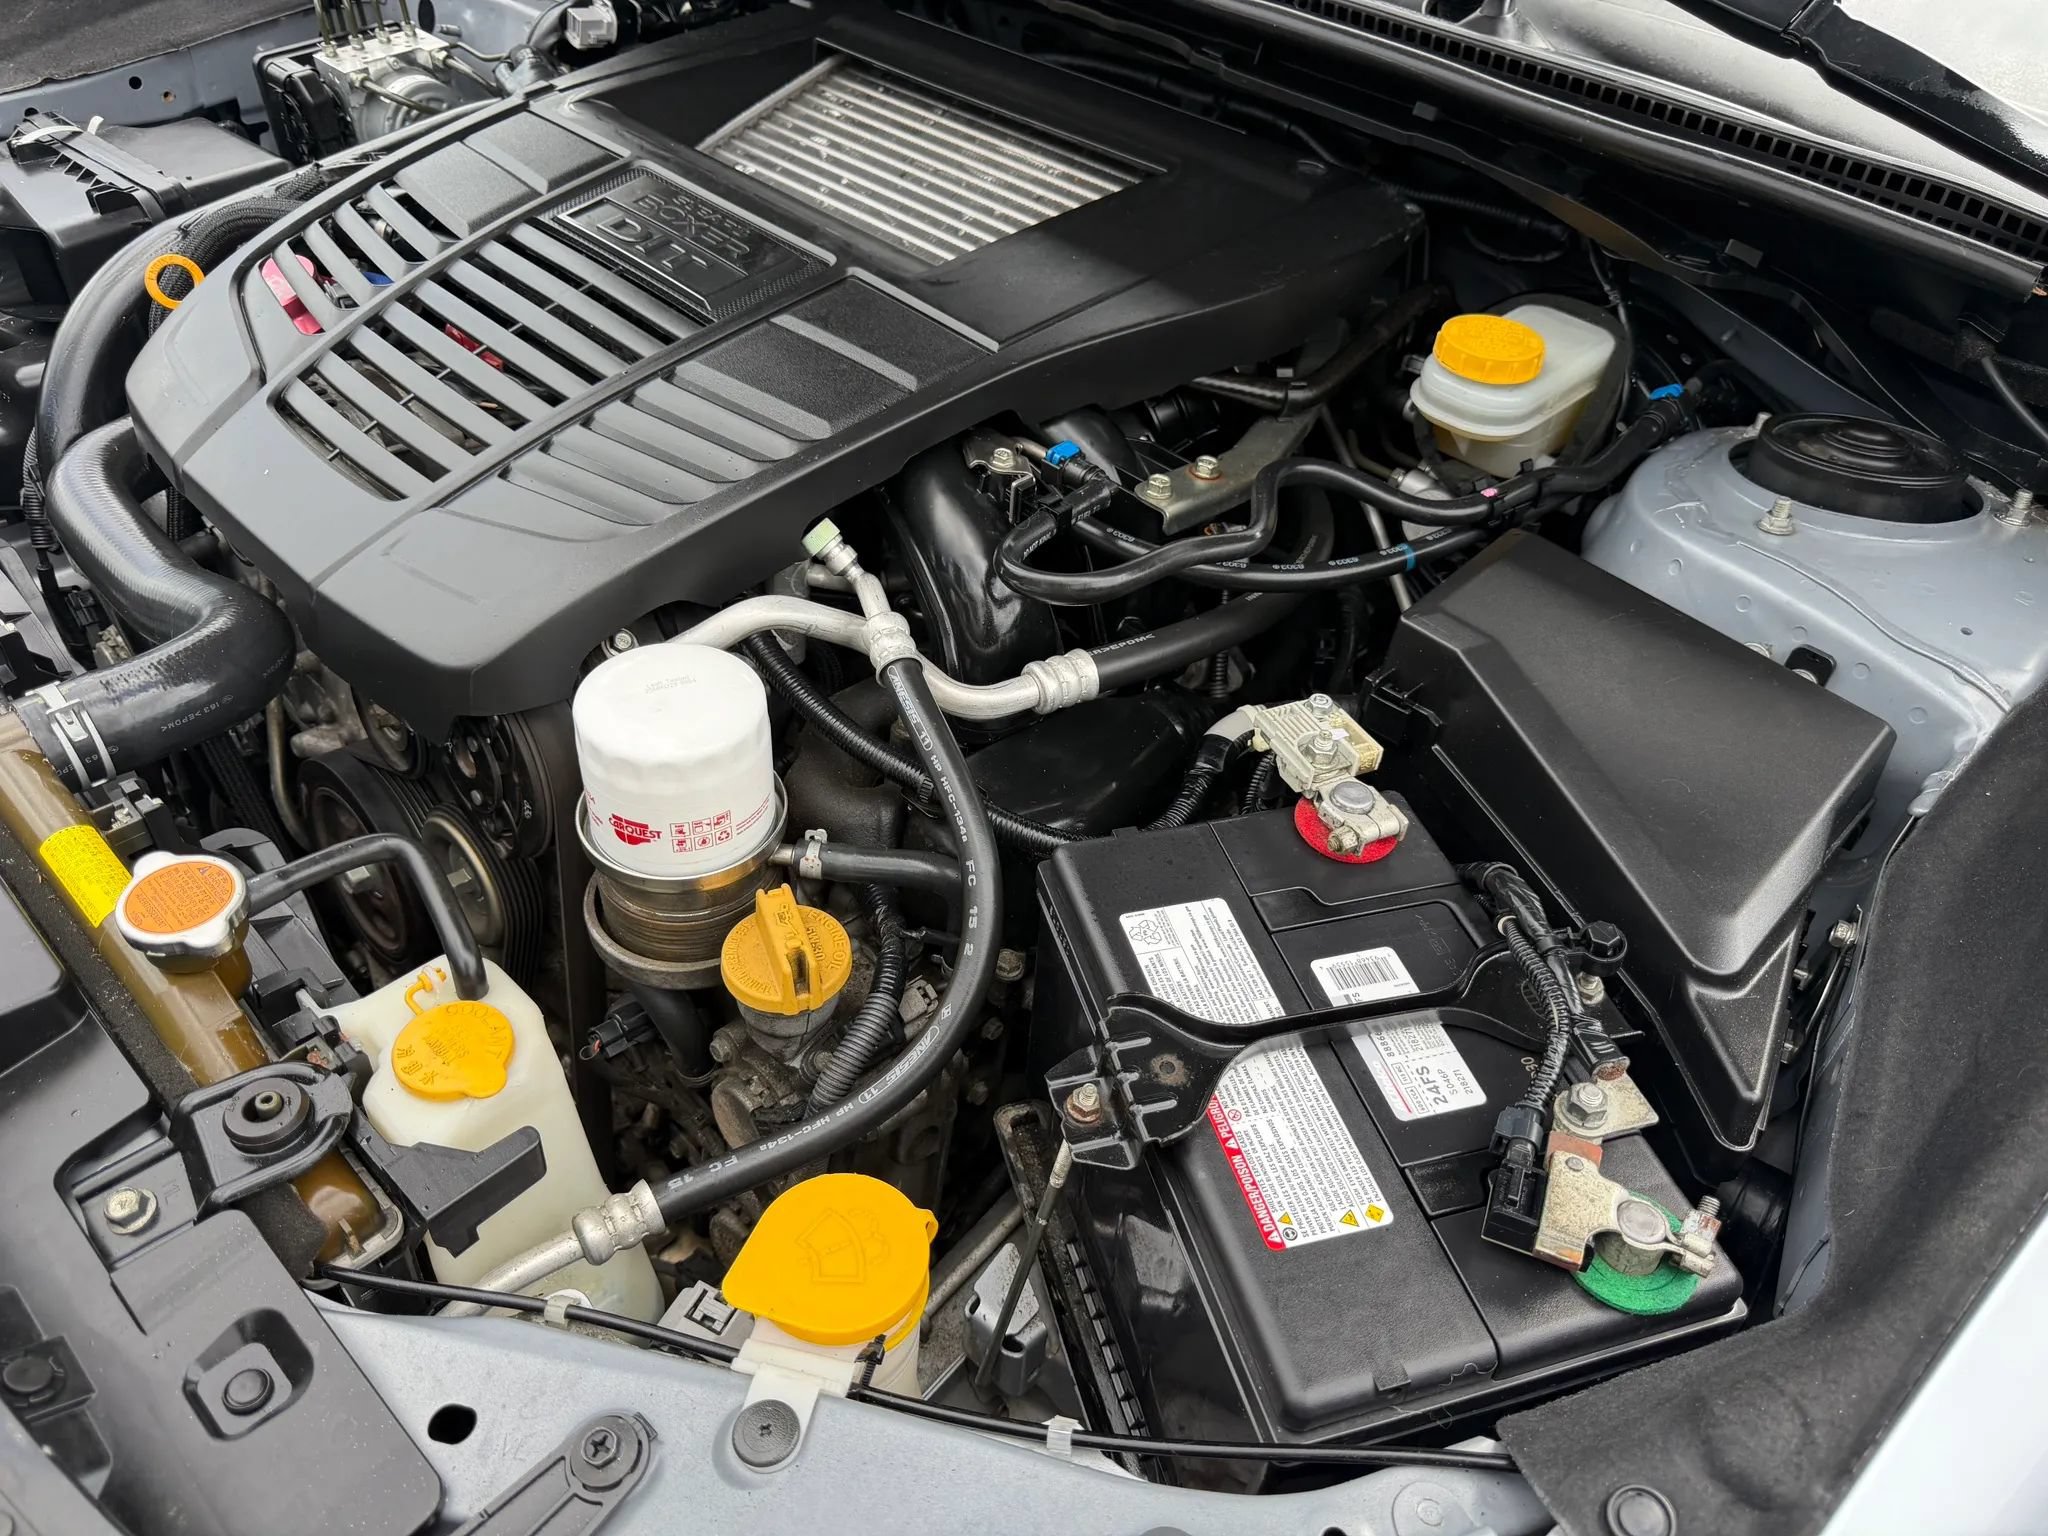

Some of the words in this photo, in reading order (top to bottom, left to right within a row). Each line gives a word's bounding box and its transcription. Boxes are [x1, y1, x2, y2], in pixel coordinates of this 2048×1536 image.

[638, 194, 750, 259] BOXER
[595, 216, 713, 272] DIT
[930, 755, 943, 772] HP
[608, 817, 663, 841] CARQUEST
[965, 859, 977, 887] FC
[808, 909, 847, 950] ENGINE
[969, 905, 979, 929] 15
[826, 951, 847, 971] OIL
[1414, 1065, 1449, 1105] 24FS
[1451, 1068, 1474, 1094] 218271
[836, 1102, 855, 1118] HP
[710, 1154, 740, 1173] FC
[1230, 1153, 1276, 1232] DANGER/POISON
